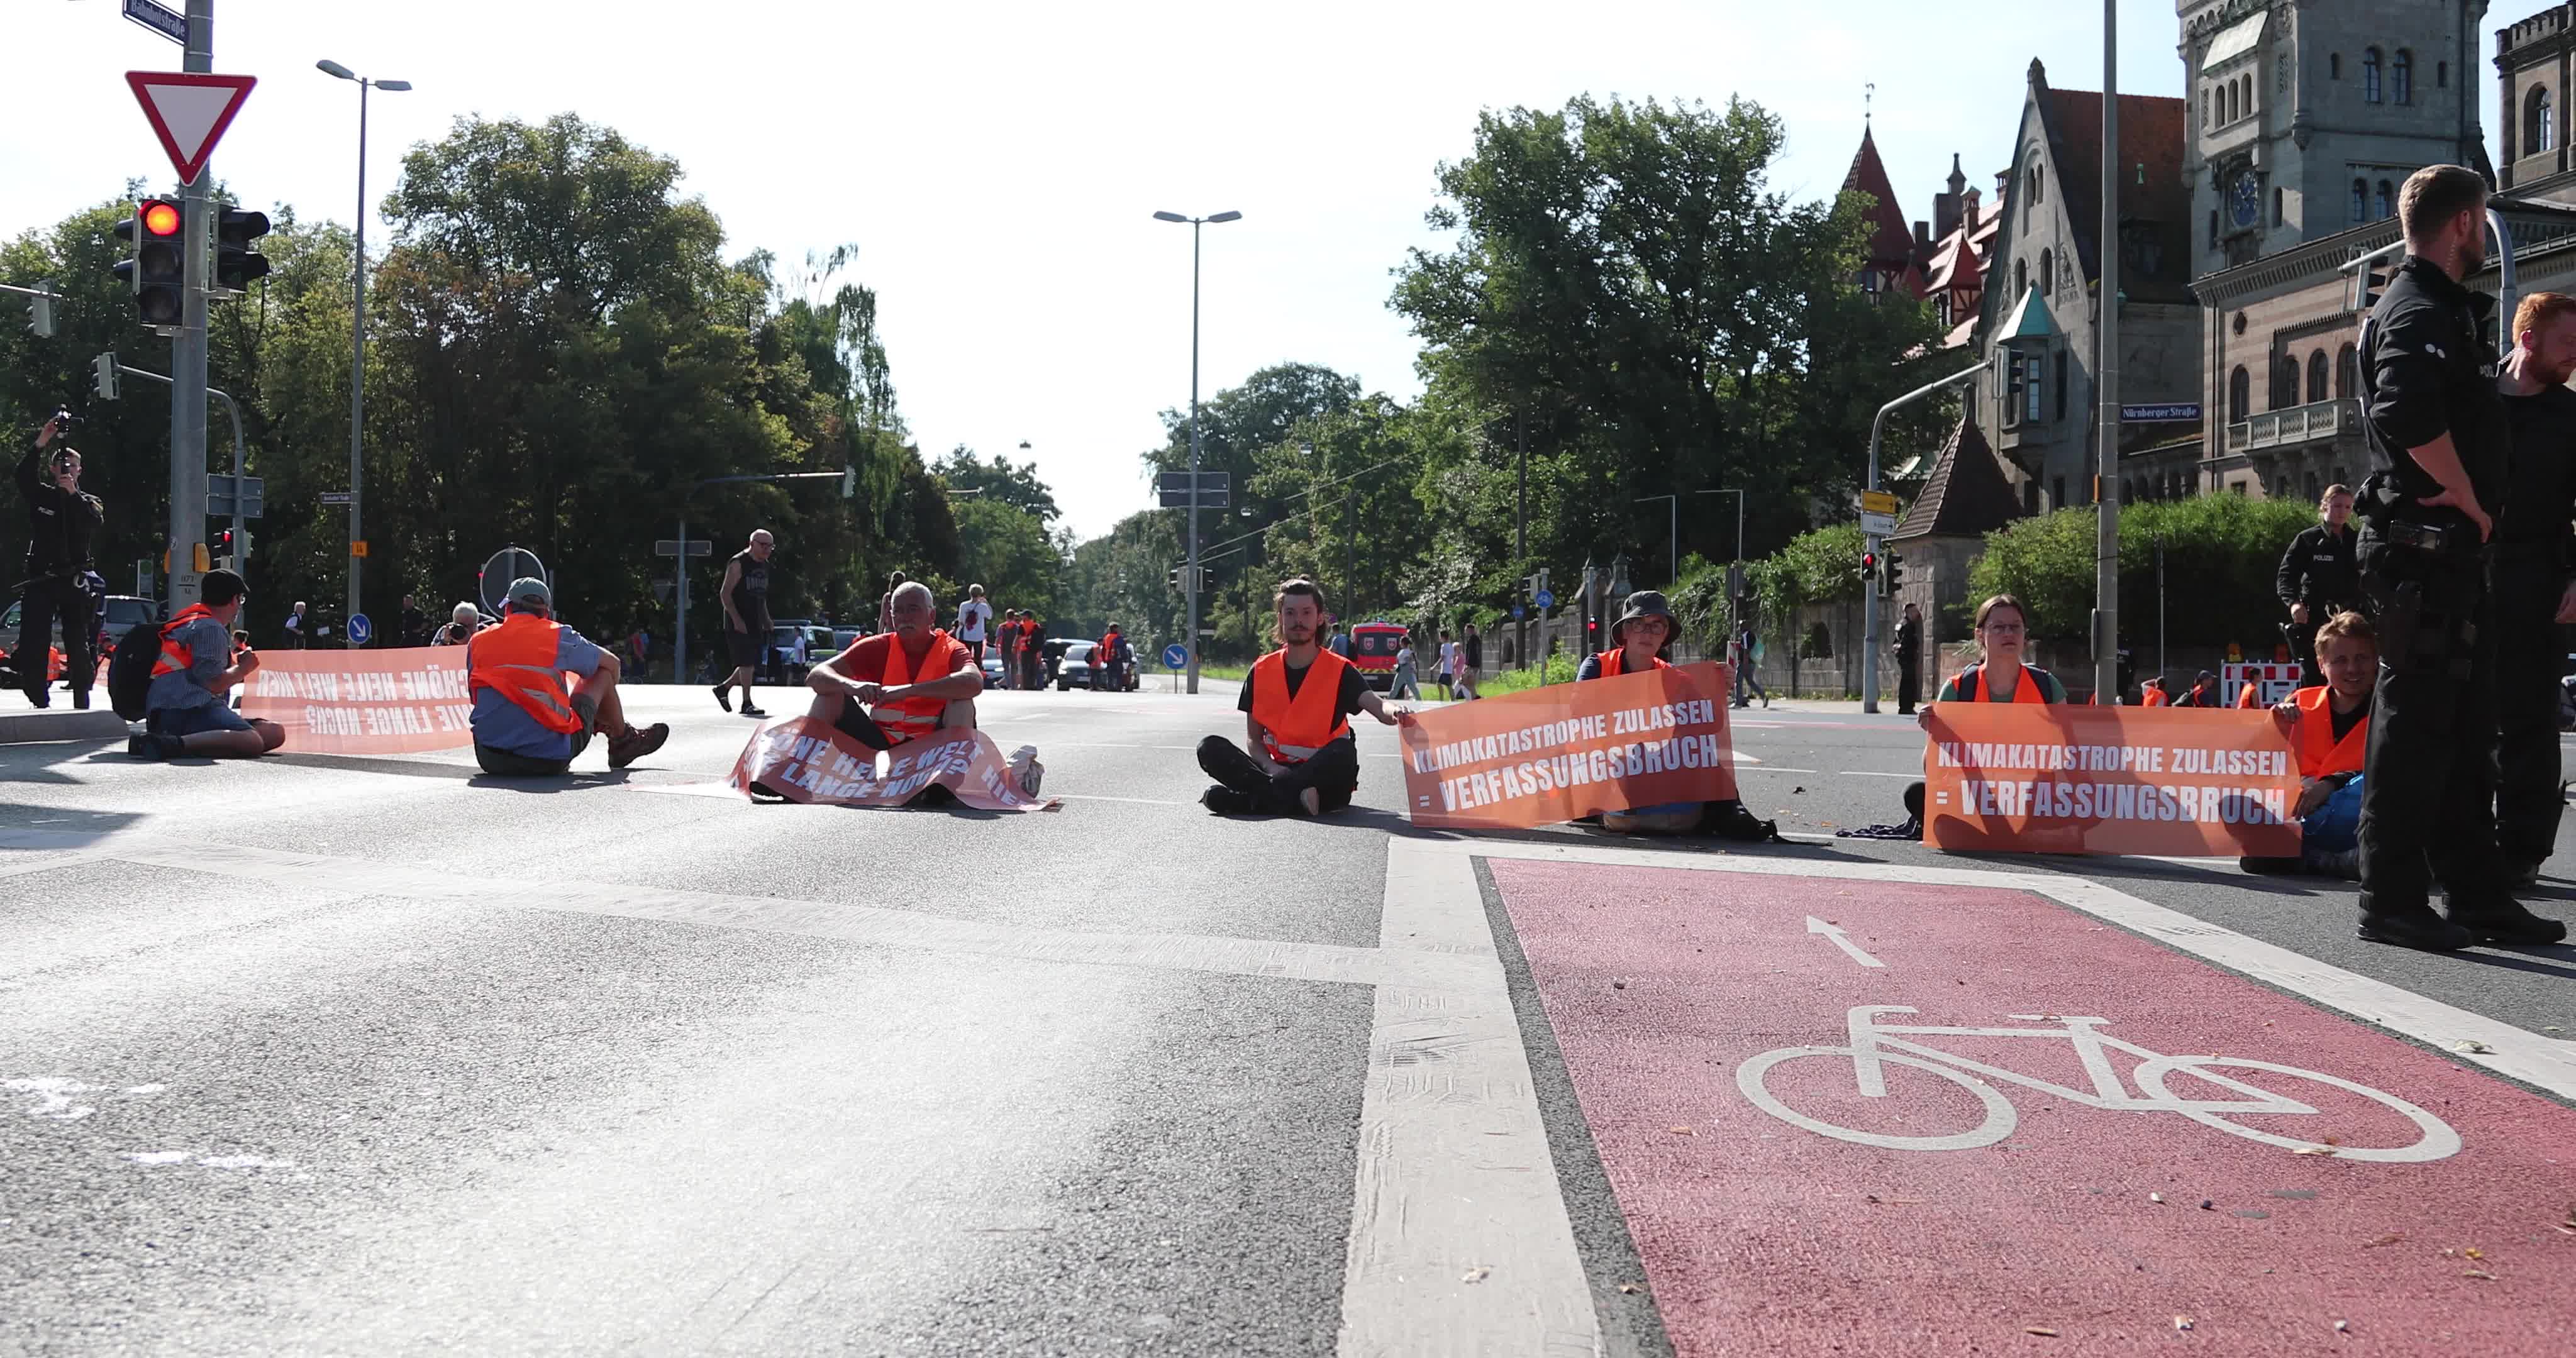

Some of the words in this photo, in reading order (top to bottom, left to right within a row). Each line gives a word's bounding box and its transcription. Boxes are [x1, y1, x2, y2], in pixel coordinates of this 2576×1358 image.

[131, 0, 185, 36] Bahnhofstraße
[2123, 407, 2169, 417] Nürnberger
[2170, 407, 2197, 417] Straße
[1414, 714, 1607, 774] KLIMAKATASTROPHE
[1613, 699, 1715, 734] ZULASSEN
[1419, 795, 1430, 807] =
[1439, 734, 1718, 812] VERFASSUNGSBRUCH
[1938, 742, 2163, 772] KLIMAKATASTROPHE
[2171, 748, 2286, 776] ZULASSEN
[780, 761, 877, 798] LANGE
[1936, 791, 1948, 804] =
[1960, 780, 2285, 825] VERFASSUNGSBRUCH
